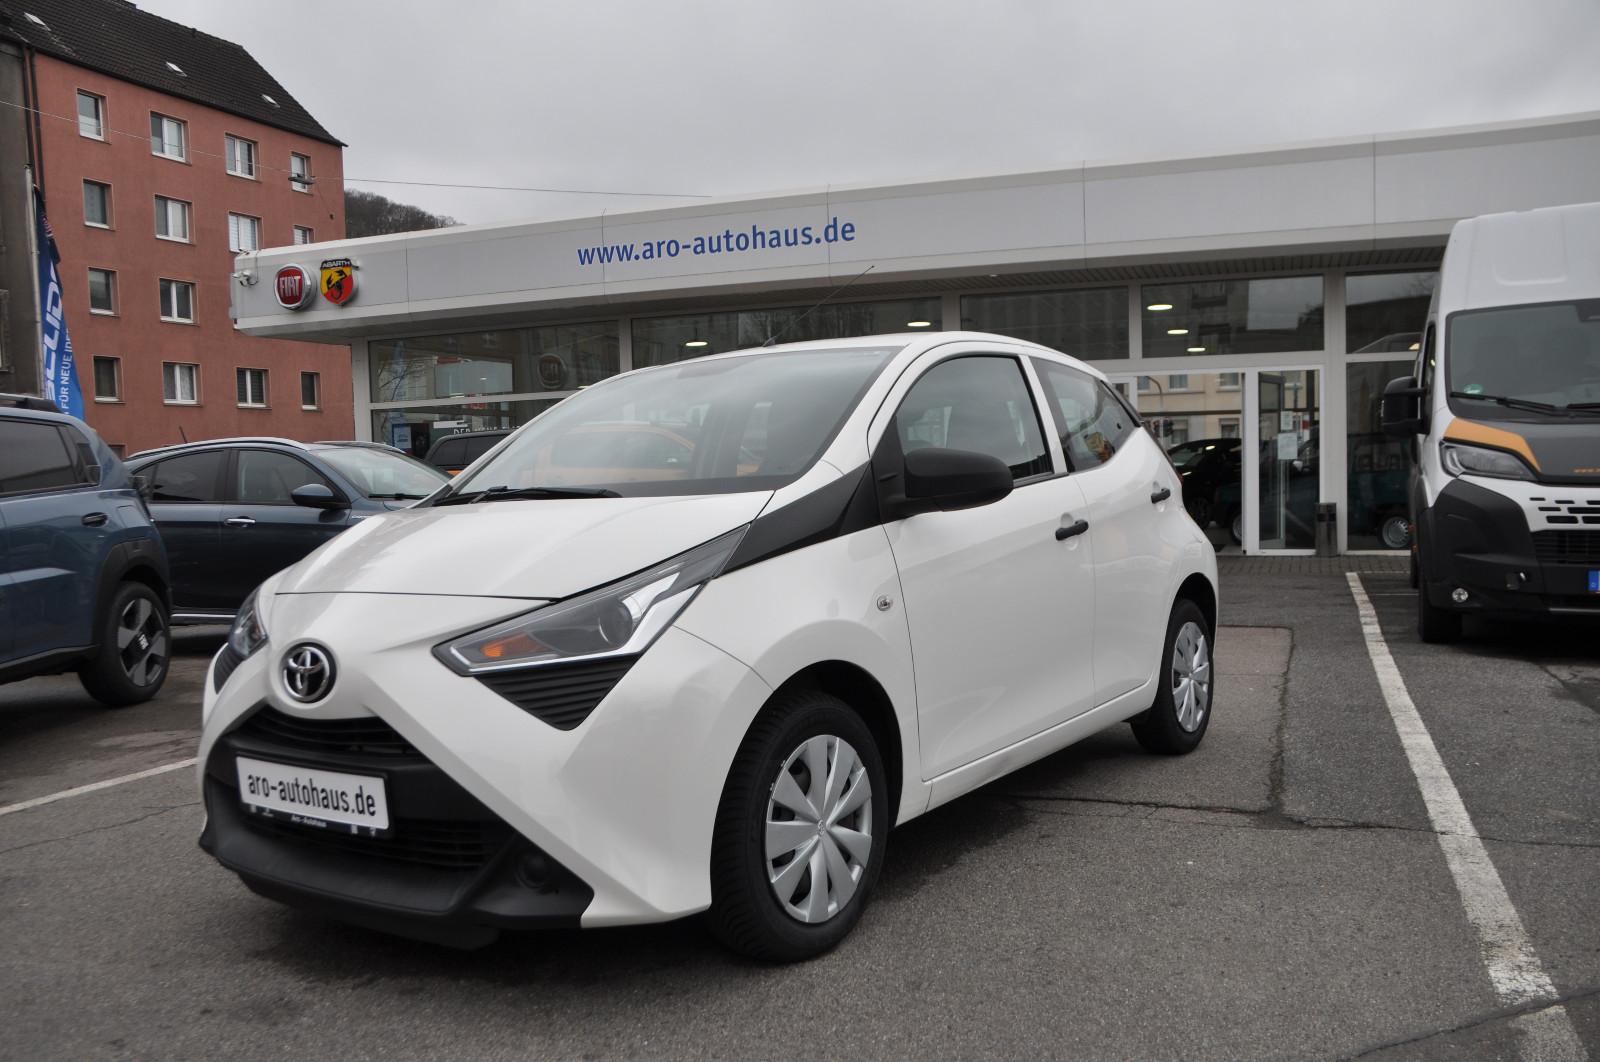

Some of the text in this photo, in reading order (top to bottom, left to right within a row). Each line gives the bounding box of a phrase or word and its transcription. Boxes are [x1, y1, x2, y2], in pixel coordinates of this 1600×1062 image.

[577, 216, 856, 266] www.aro-autohaus.de
[322, 260, 350, 268] ABARTH
[279, 275, 301, 298] FIAT
[60, 354, 73, 384] NEUE
[59, 387, 70, 409] FÜR
[248, 774, 376, 817] aro-autohaus.de
